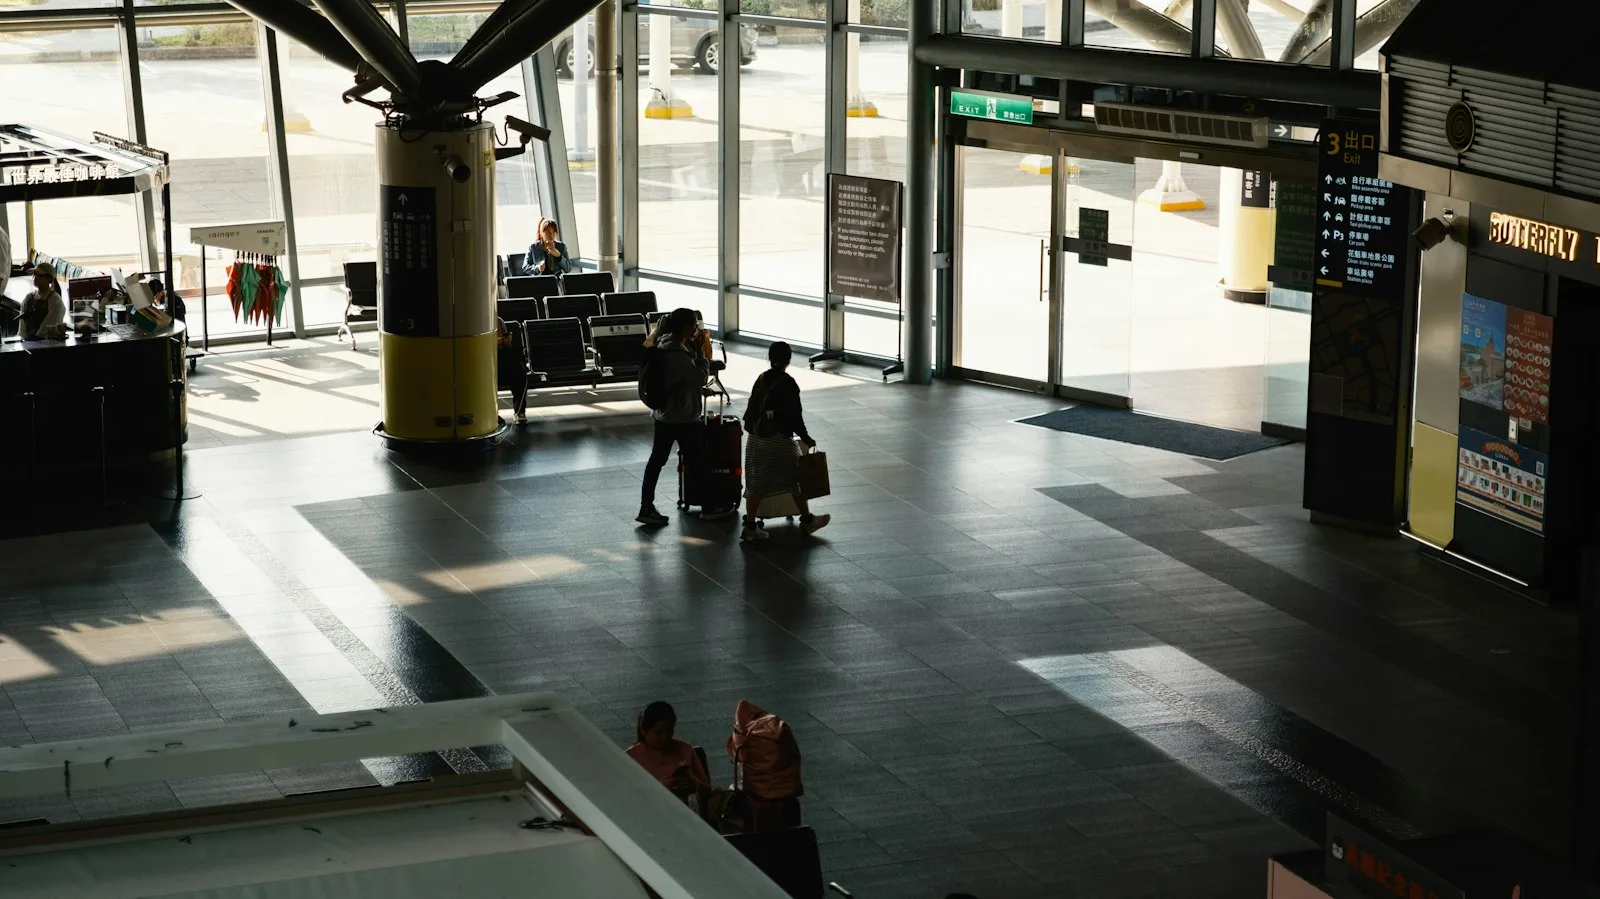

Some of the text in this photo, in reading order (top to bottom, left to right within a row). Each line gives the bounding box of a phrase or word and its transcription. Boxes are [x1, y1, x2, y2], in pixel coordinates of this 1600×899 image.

[958, 105, 980, 114] EXIT
[1003, 111, 1026, 121] 緊急出口
[1327, 133, 1340, 155] 3
[1344, 130, 1375, 151] 出口
[1343, 152, 1361, 165] Exit
[11, 163, 120, 186] 世界最佳咖啡館
[1333, 230, 1345, 241] P3
[1348, 230, 1370, 241] 停車場
[1489, 211, 1579, 262] BUTTERFLY
